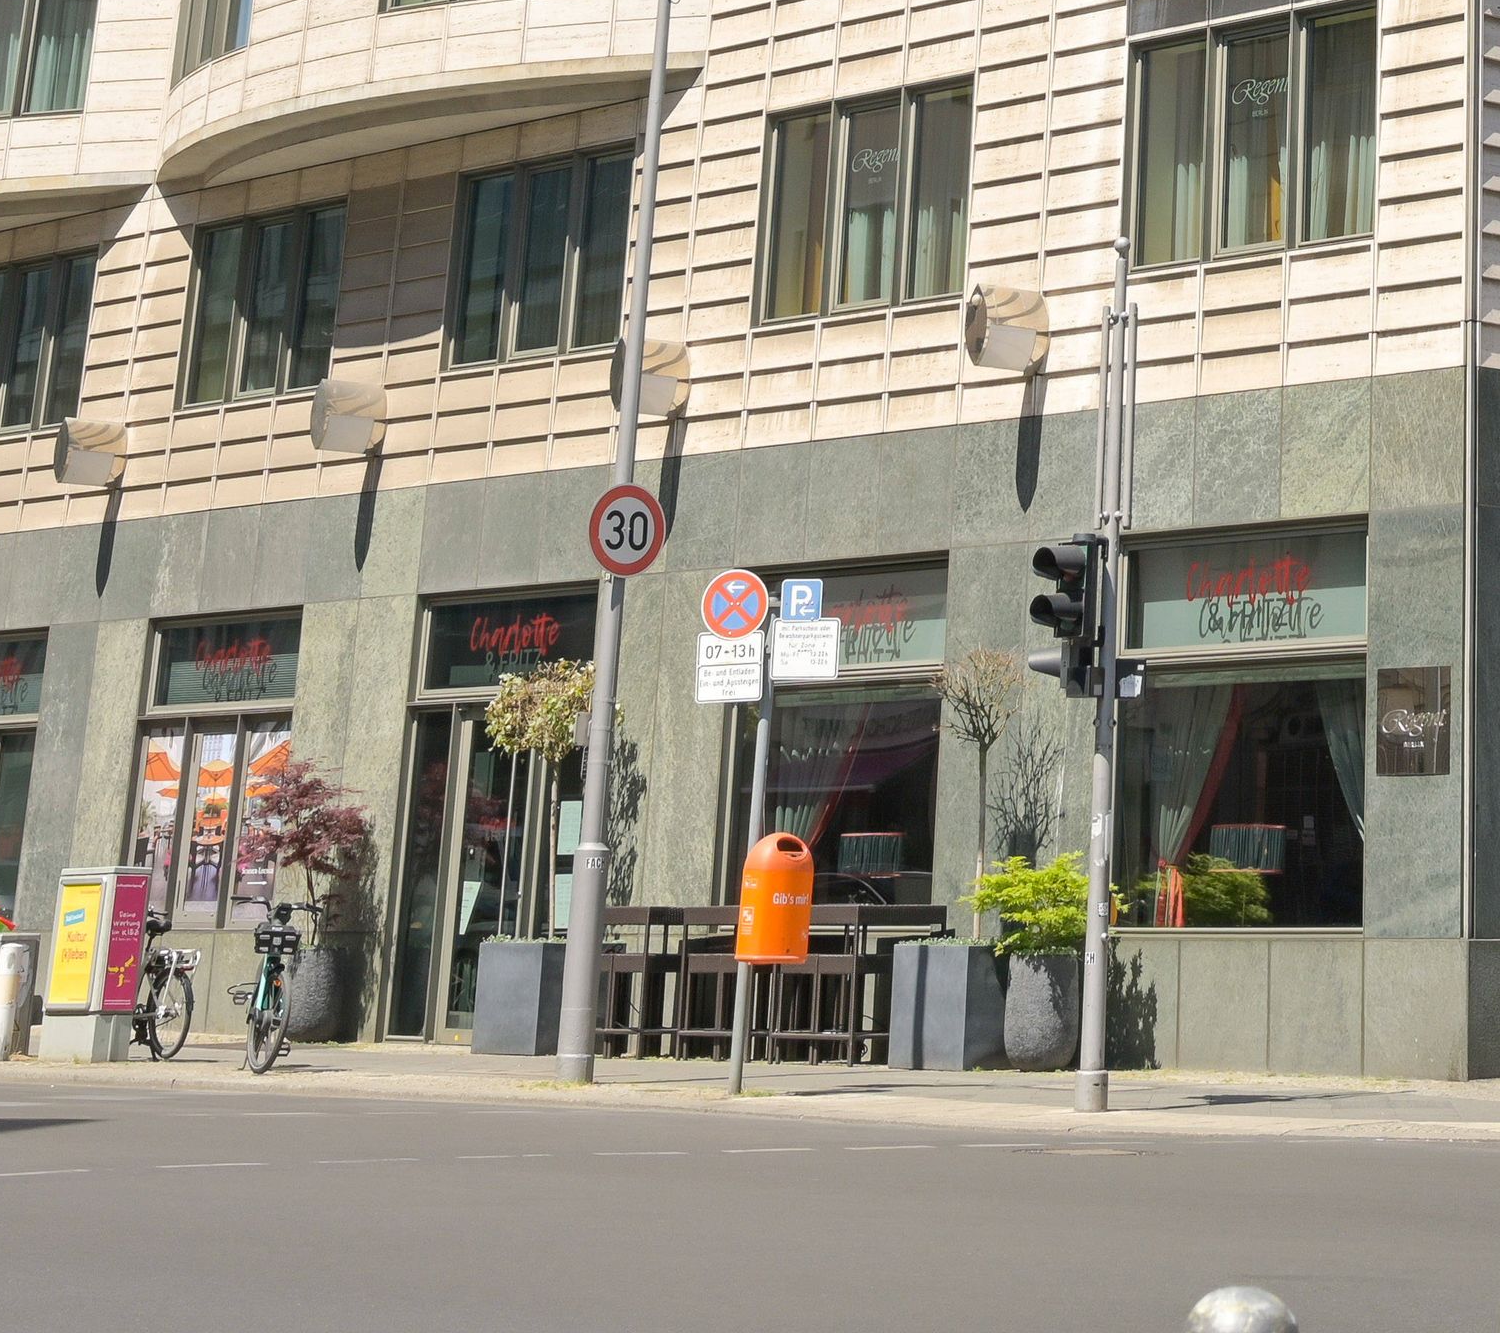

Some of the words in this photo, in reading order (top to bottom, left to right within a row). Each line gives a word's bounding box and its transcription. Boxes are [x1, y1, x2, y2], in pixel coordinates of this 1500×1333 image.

[605, 510, 648, 551] 30
[1186, 551, 1312, 608] Charlotte
[470, 612, 562, 656] Charlotte
[772, 892, 794, 905] Gib's
[795, 893, 809, 906] mir!
